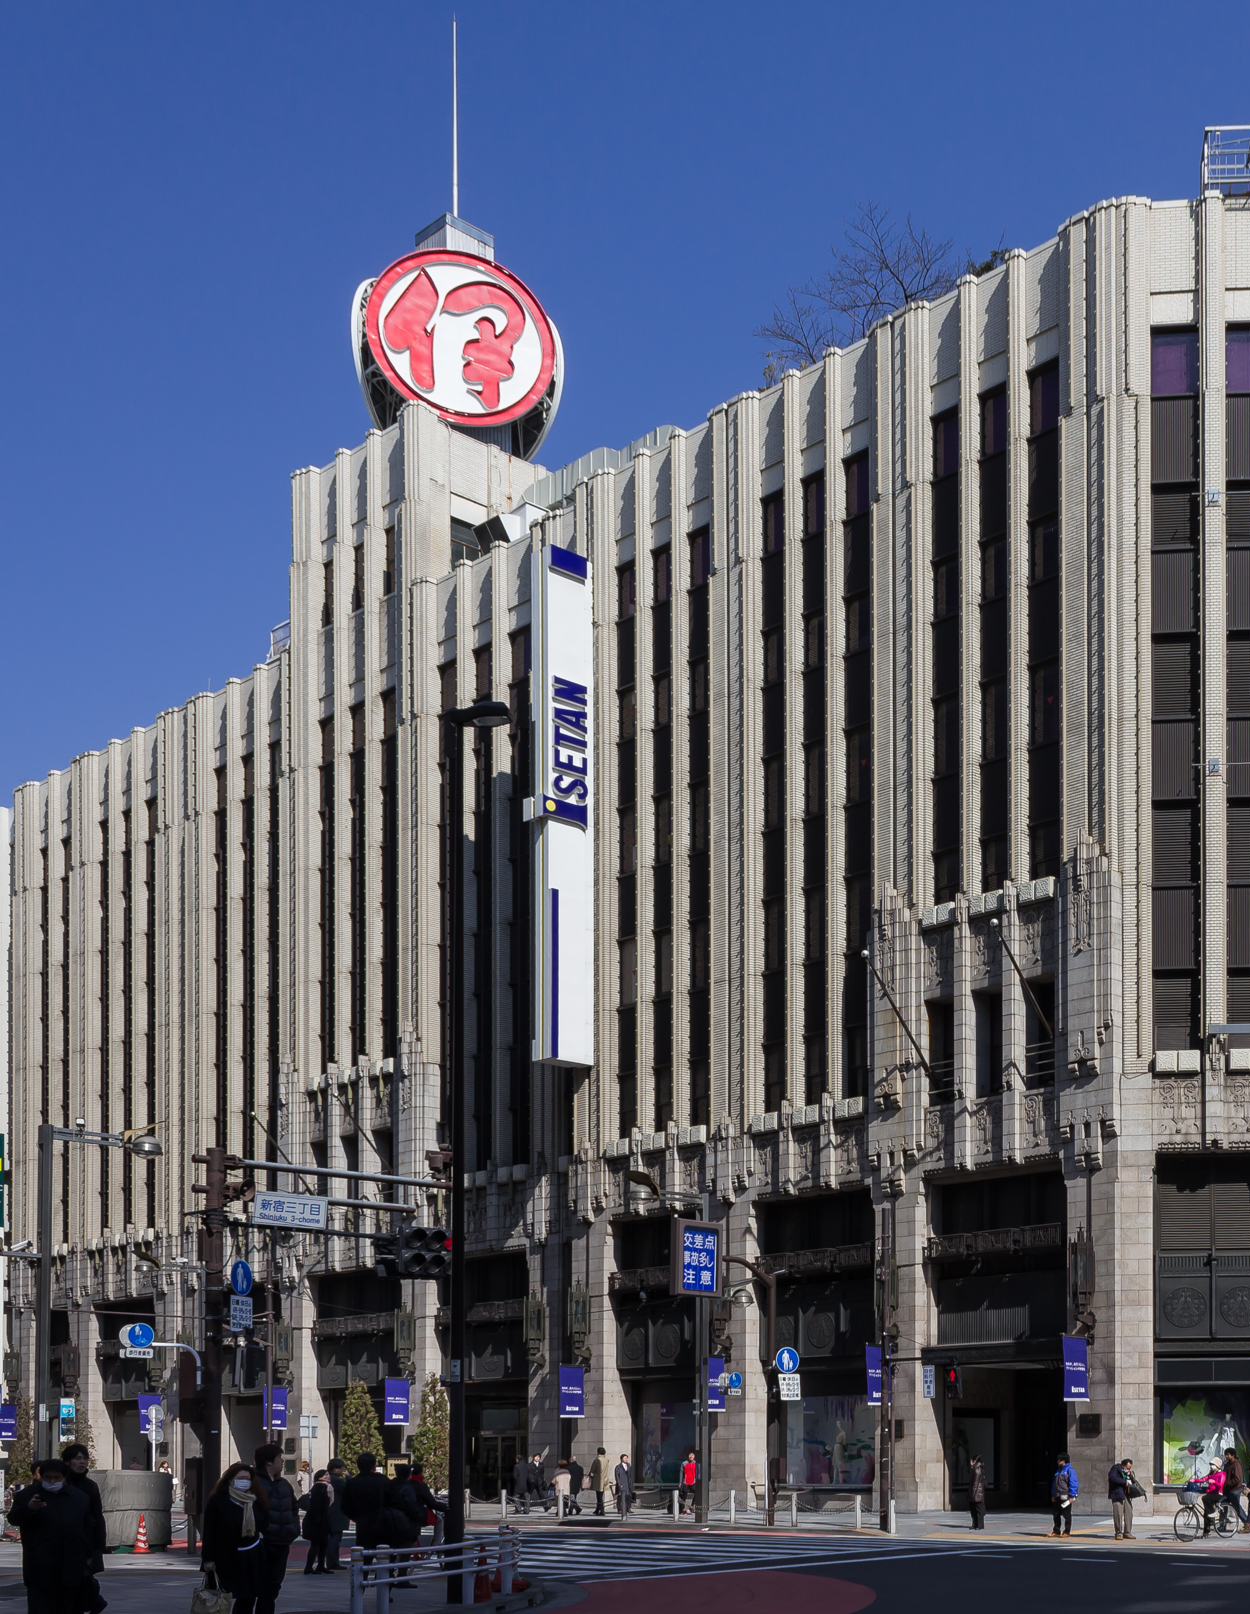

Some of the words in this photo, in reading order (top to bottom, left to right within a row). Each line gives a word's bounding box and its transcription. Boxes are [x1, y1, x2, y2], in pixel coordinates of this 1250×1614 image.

[260, 1198, 321, 1216] 新宿三丁目
[259, 1212, 288, 1222] Shinjuku
[290, 1215, 320, 1224] 3-chome
[684, 1233, 715, 1250] 交差点
[683, 1251, 714, 1268] 事故多し
[683, 1268, 712, 1285] 注意
